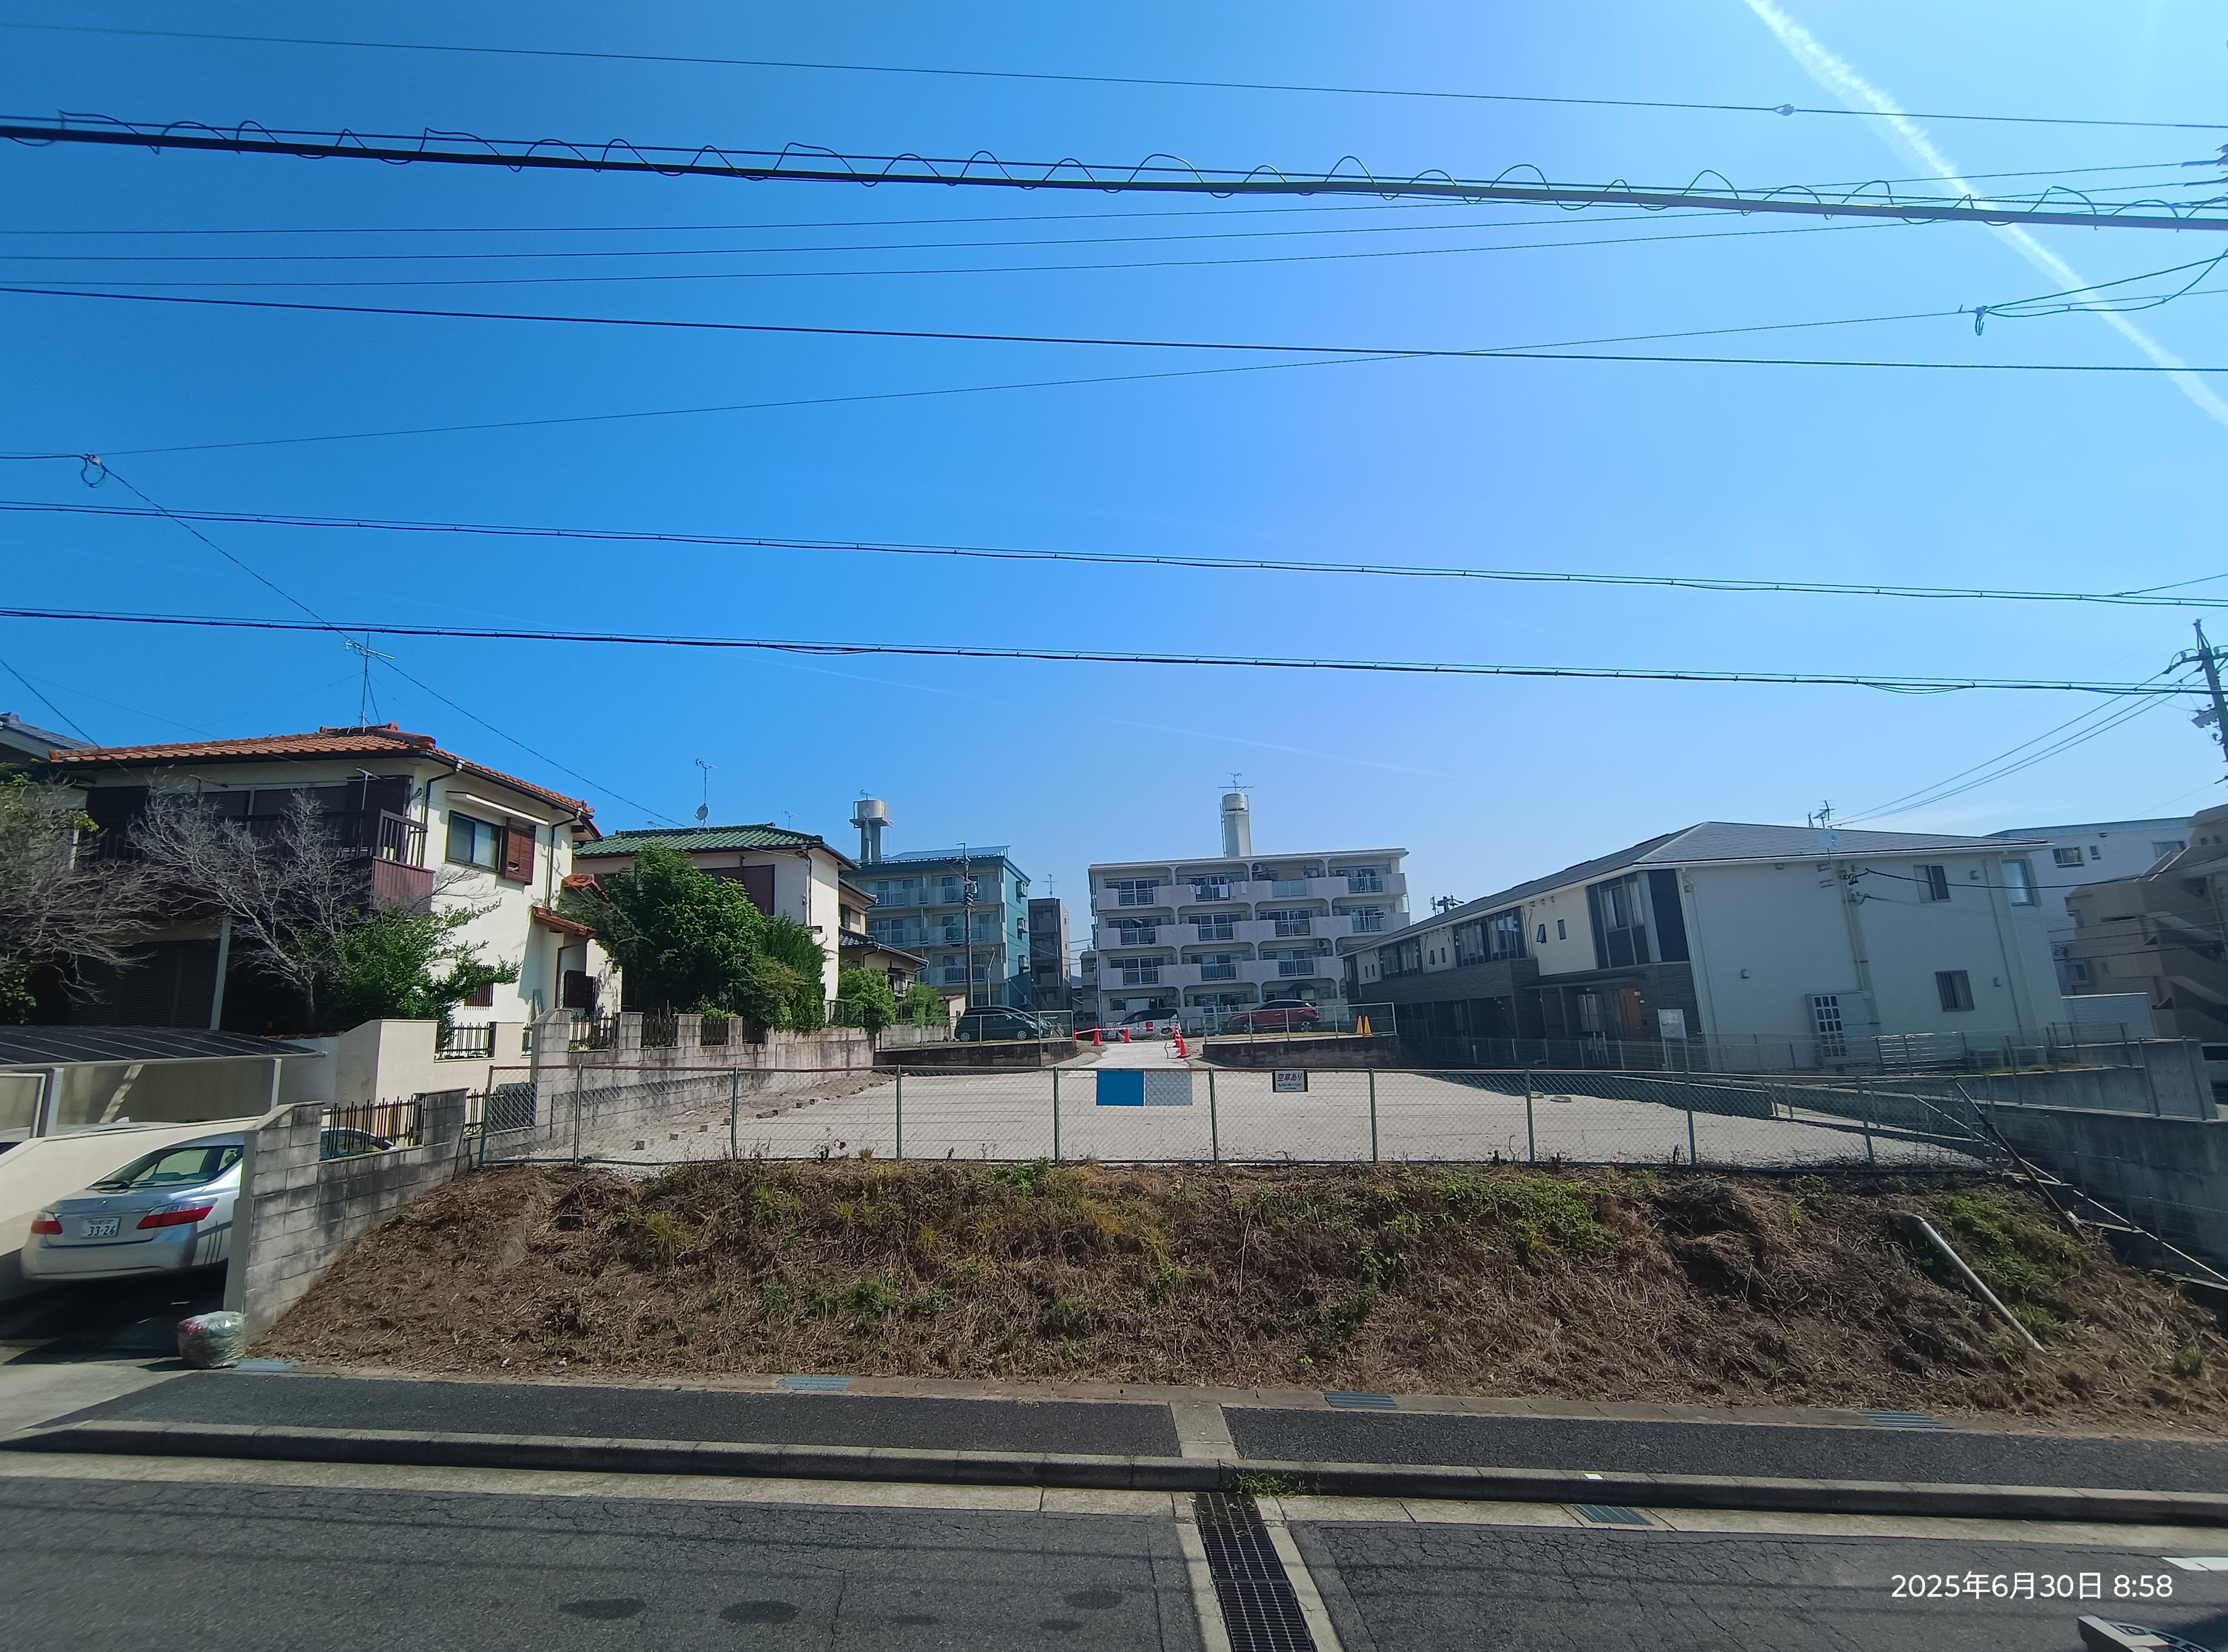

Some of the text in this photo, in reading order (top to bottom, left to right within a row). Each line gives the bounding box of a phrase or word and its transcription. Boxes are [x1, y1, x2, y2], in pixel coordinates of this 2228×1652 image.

[1277, 1073, 1303, 1081] 空車あり
[88, 1226, 116, 1236] 33-26
